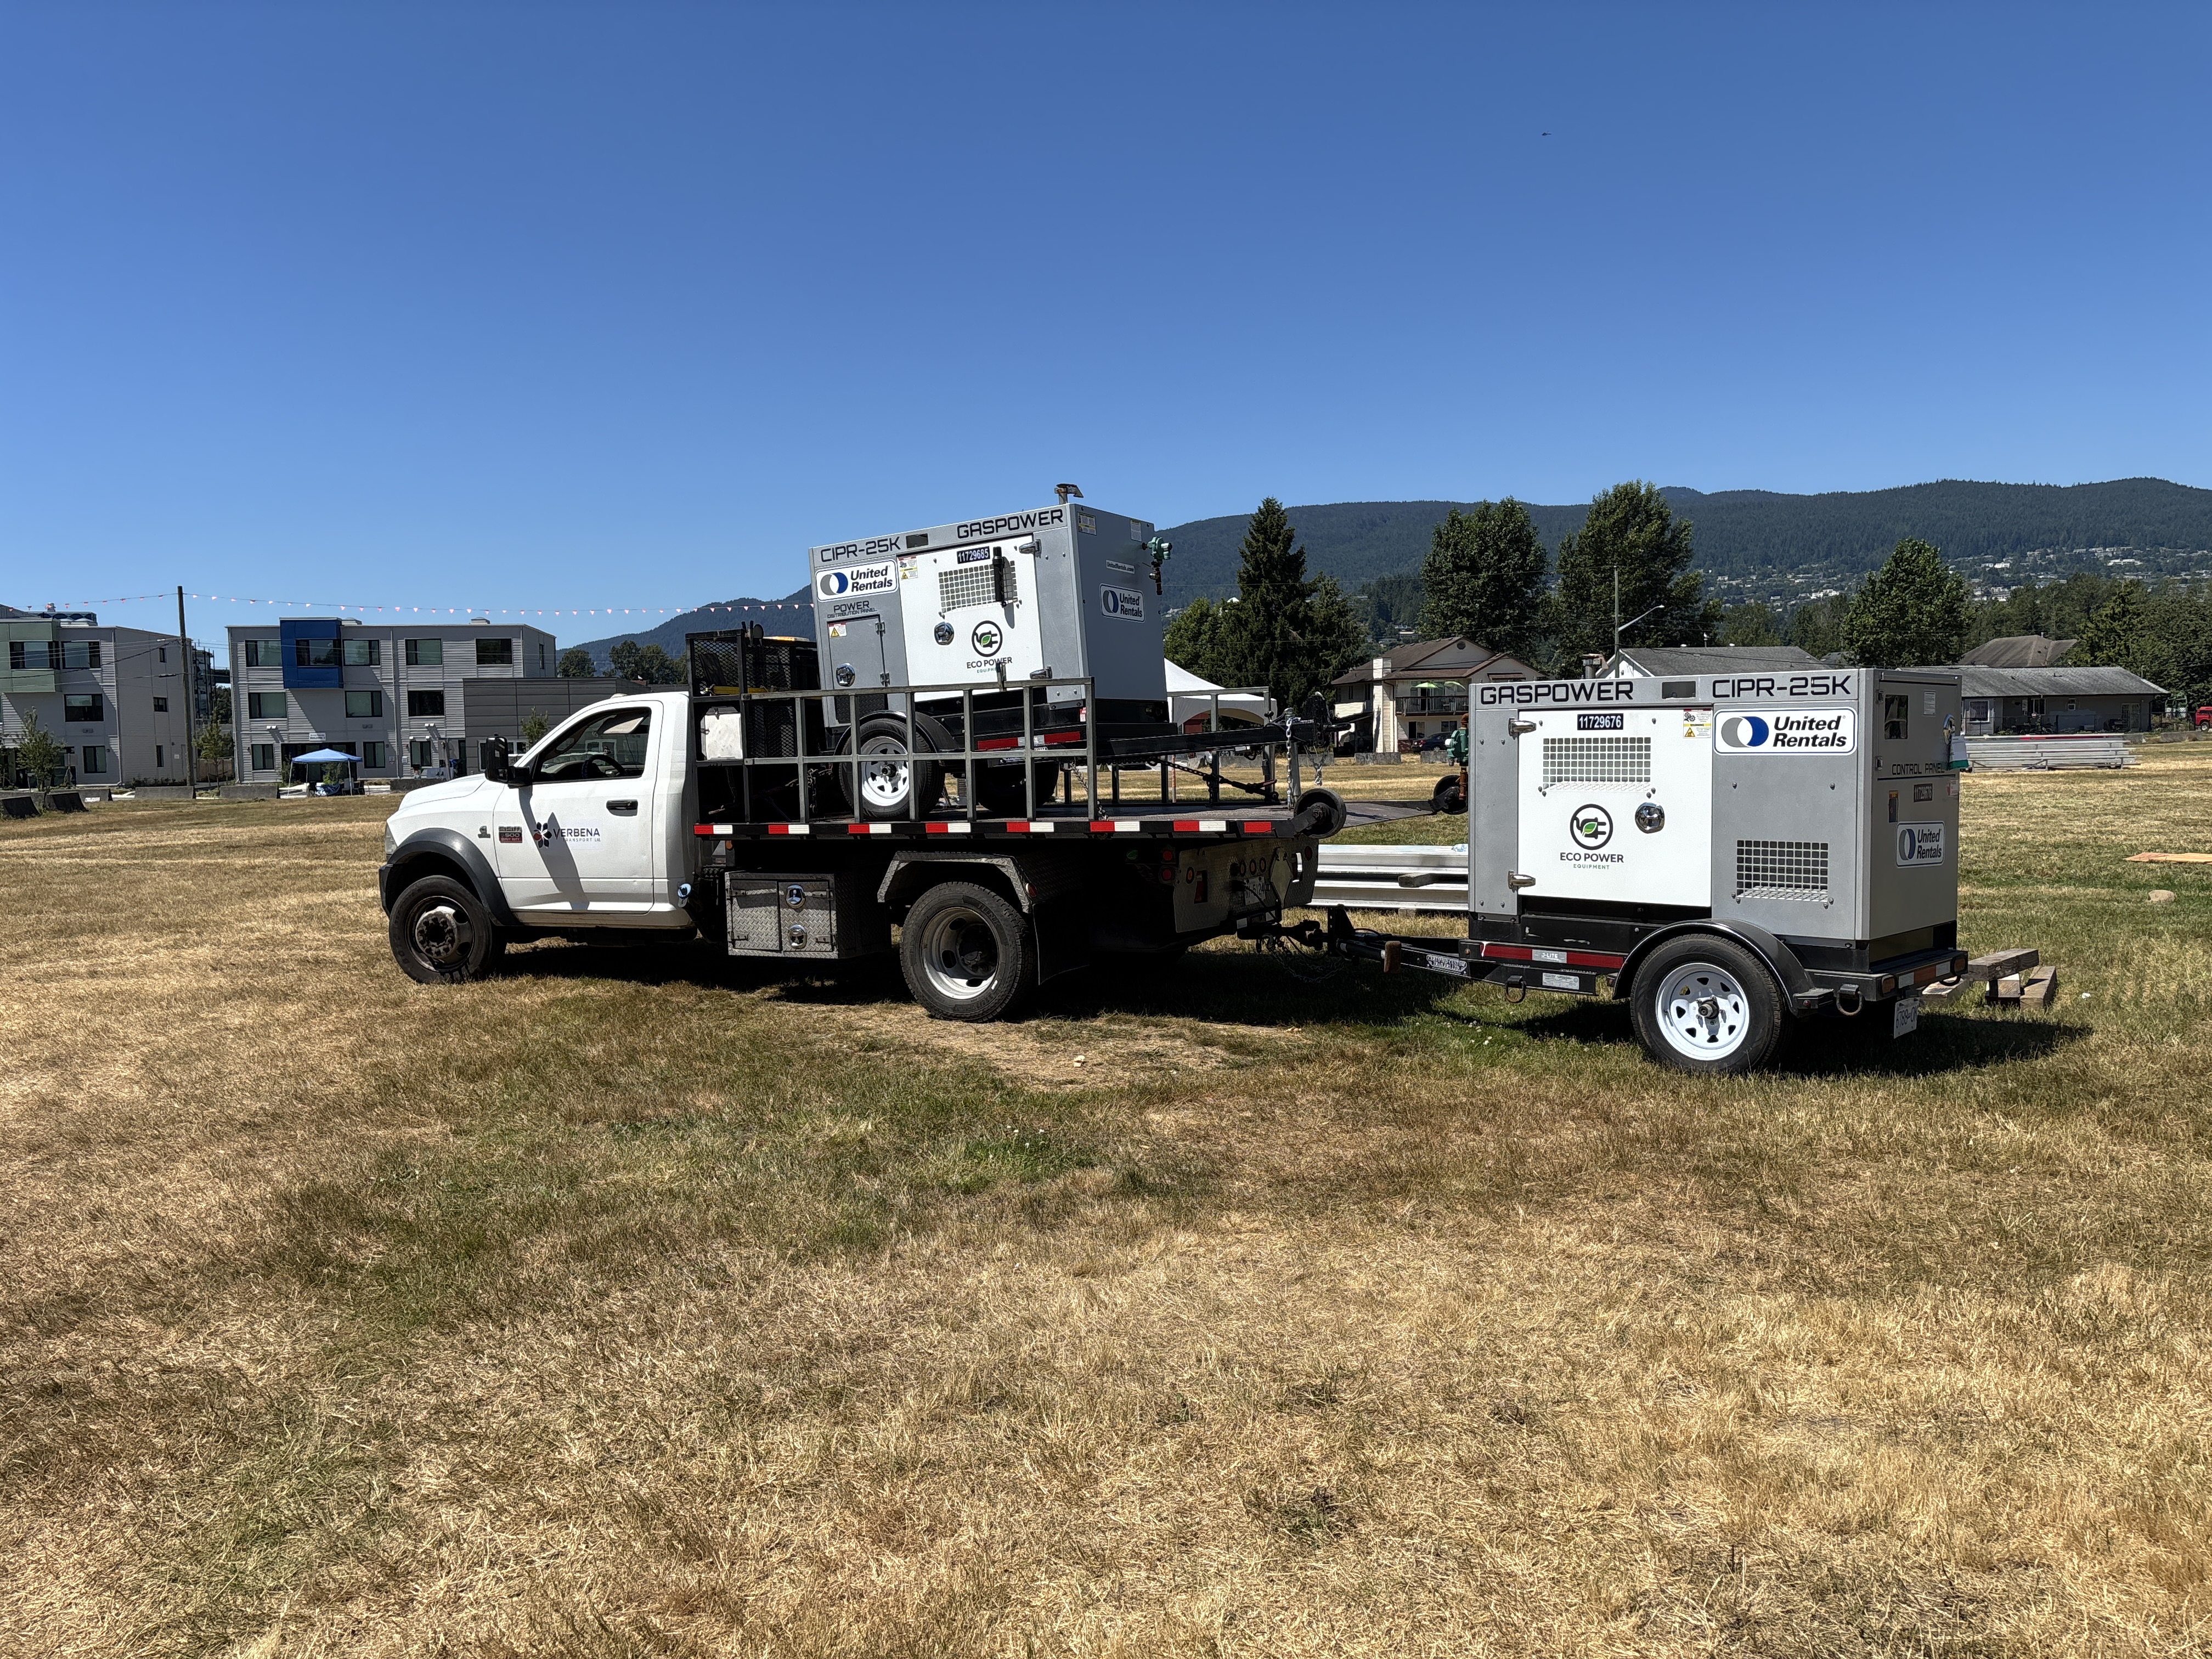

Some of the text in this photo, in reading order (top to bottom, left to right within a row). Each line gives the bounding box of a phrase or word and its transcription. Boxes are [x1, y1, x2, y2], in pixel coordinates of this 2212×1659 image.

[957, 509, 1063, 538] GASPOWER
[820, 536, 901, 562] CIPR-25K
[958, 548, 989, 562] 11729685
[850, 565, 889, 580] United
[851, 577, 893, 592] Rentals
[1120, 592, 1141, 606] United
[834, 600, 870, 613] POWER
[1120, 605, 1143, 618] Rentals
[827, 610, 860, 619] DISTRIBUTION
[966, 657, 1012, 669] ECO POWER
[1481, 675, 1852, 705] GASPOWER CIPR-25K
[1579, 715, 1622, 729] 11729676
[1774, 715, 1842, 731] United
[1773, 732, 1847, 748] Rentals
[1892, 763, 1945, 775] CONTROL PANEL
[553, 828, 600, 840] VERBENA
[1917, 828, 1942, 844] United
[1560, 852, 1624, 863] ECO POWER
[1916, 844, 1943, 860] Rentals
